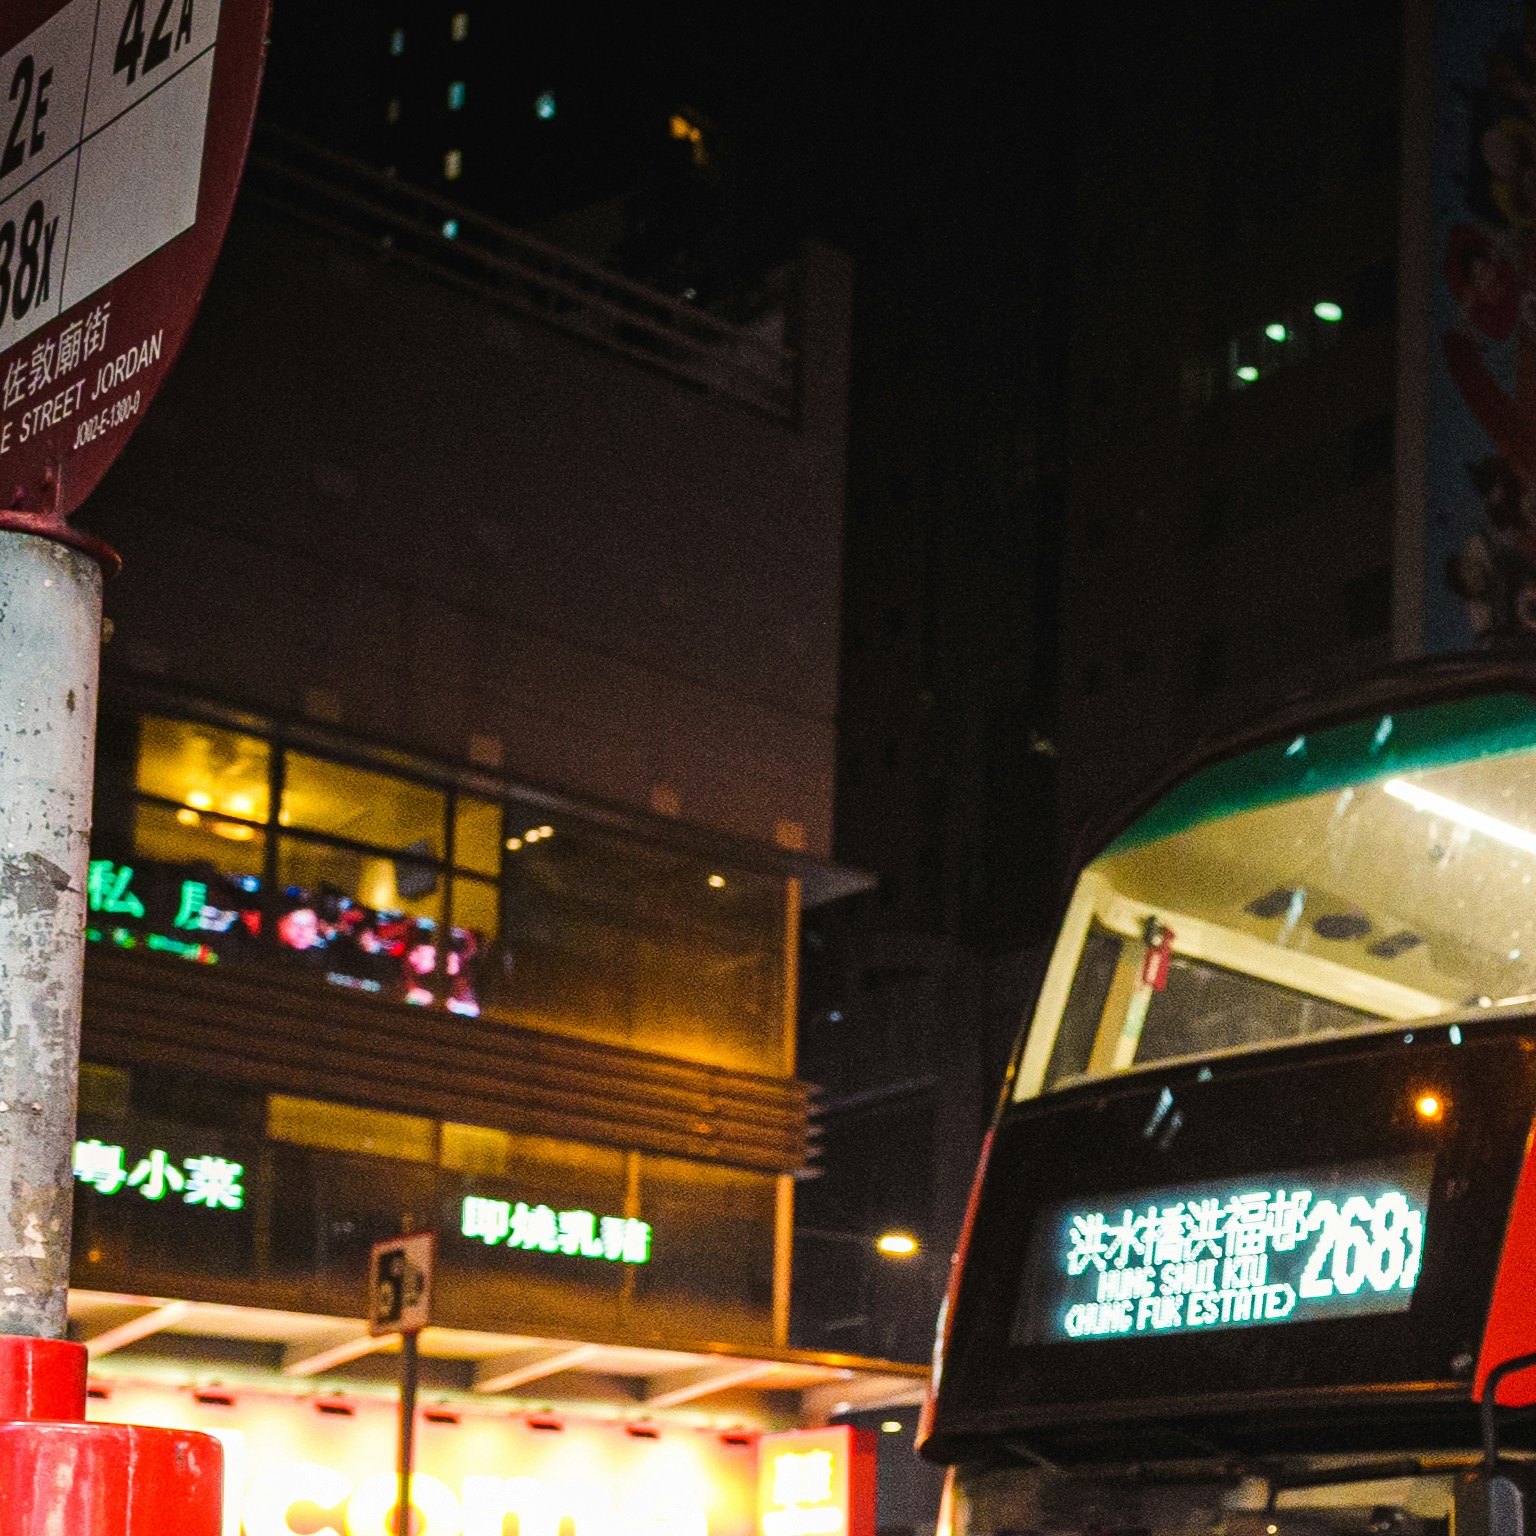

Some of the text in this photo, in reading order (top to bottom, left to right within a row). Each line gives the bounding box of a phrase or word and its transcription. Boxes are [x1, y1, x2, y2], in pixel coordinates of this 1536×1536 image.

[3, 302, 111, 411] 佐敦廟街
[20, 378, 86, 442] STREET
[91, 329, 163, 400] JORDAN
[1096, 1252, 1268, 1303] HUNG SHUI KIU
[1135, 1293, 1185, 1331] FUK
